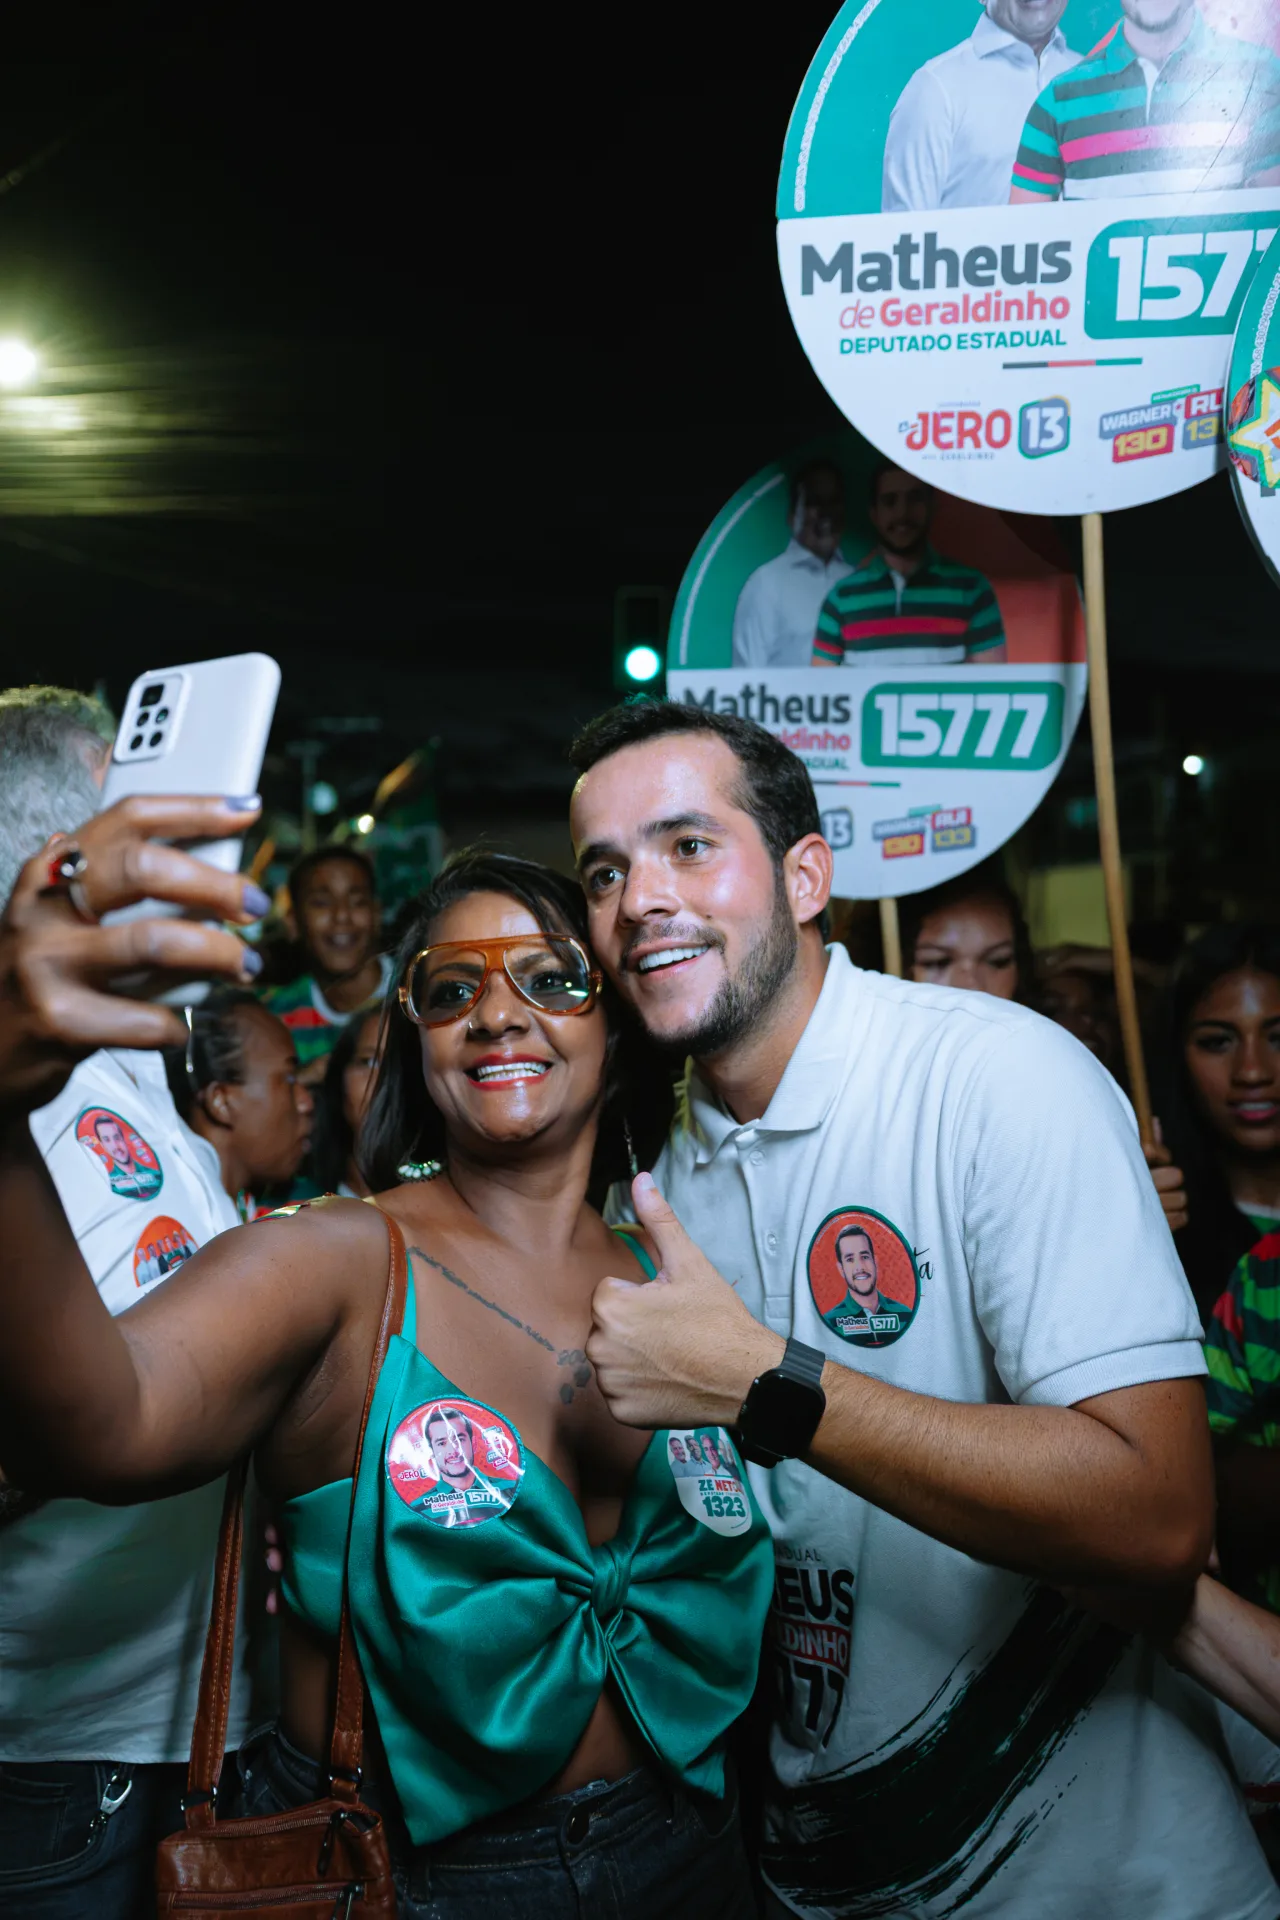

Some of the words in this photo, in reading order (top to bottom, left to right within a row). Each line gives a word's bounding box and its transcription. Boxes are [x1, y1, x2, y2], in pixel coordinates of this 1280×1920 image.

[801, 231, 1072, 296] Matheus
[839, 299, 875, 329] de
[880, 289, 1071, 327] Geraldinho
[839, 333, 953, 355] DEPUTADO
[956, 328, 1068, 351] ESTADUAL
[905, 408, 1013, 452] JERO
[1026, 406, 1066, 450] 13
[1102, 403, 1172, 432] WAGNER
[1114, 426, 1169, 457] 130
[683, 683, 852, 725] Matheus
[777, 727, 852, 751] ldinho
[874, 693, 1049, 759] 15777
[823, 813, 848, 847] 13
[424, 1492, 464, 1505] Matheus
[702, 1495, 746, 1518] 1323
[775, 1566, 855, 1627] EUS
